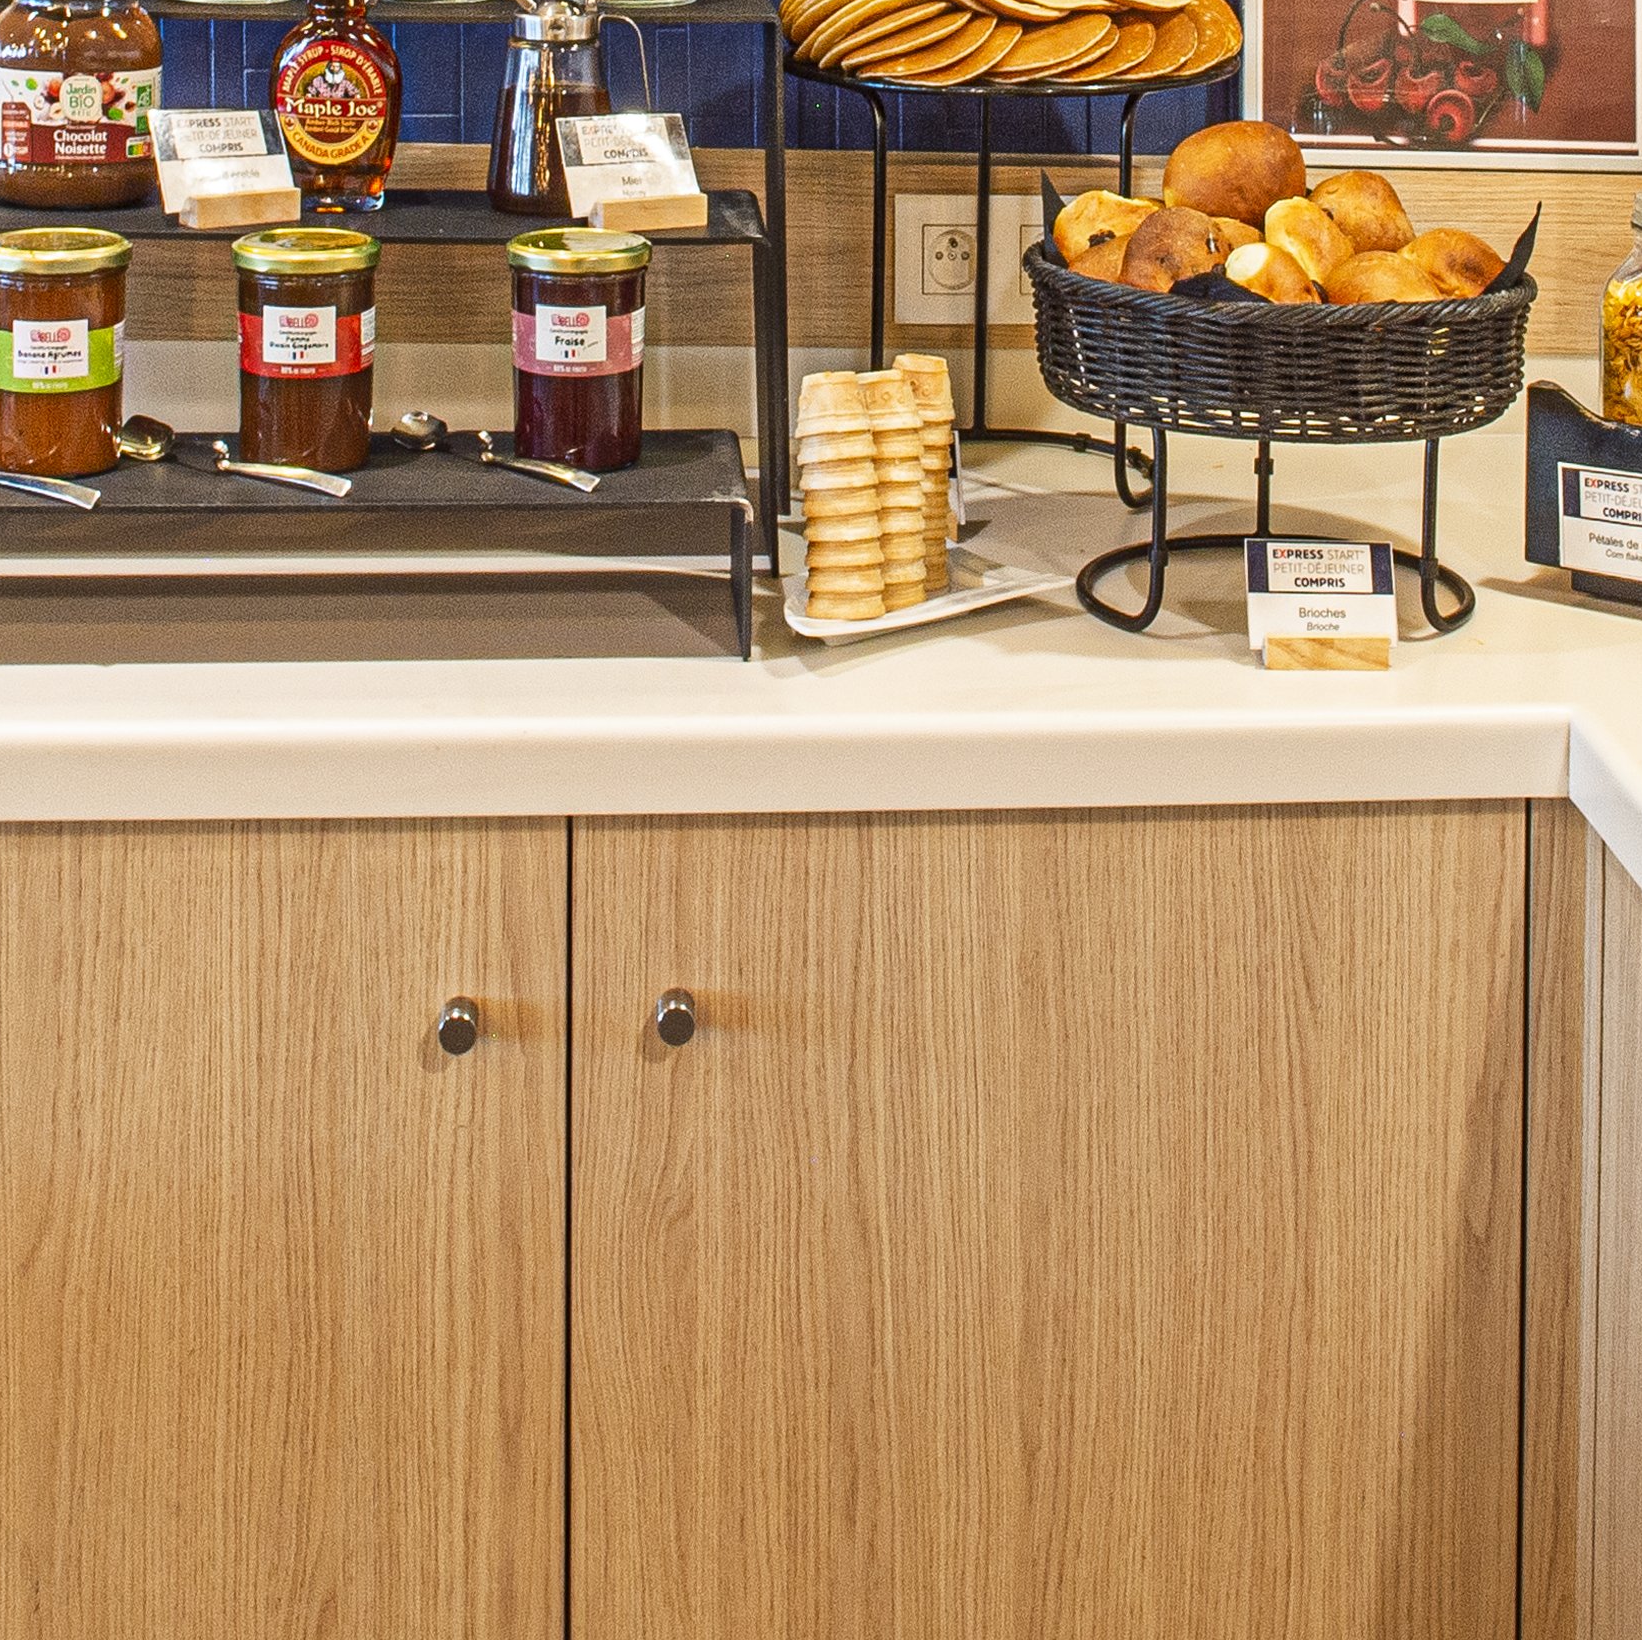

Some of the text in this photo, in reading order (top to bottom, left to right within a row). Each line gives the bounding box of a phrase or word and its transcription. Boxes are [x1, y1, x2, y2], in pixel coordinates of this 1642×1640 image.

[66, 83, 97, 95] Jardin
[285, 97, 342, 118] Maple
[177, 118, 222, 129] PRESS
[53, 130, 108, 143] Chocolat
[54, 142, 107, 155] Noisette
[199, 142, 244, 153] COMPRIS
[293, 132, 329, 158] CANADA
[554, 335, 585, 346] Fraise
[1584, 477, 1630, 493] EXPRESS
[1588, 532, 1624, 548] Pétales
[1626, 539, 1639, 550] de
[1272, 548, 1324, 560] EXPRESS
[1273, 561, 1365, 575] PETIT-DÉJEUNER
[1294, 577, 1346, 588] COMPRIS
[1298, 607, 1347, 619] Brioches
[1306, 622, 1340, 631] Brioche
